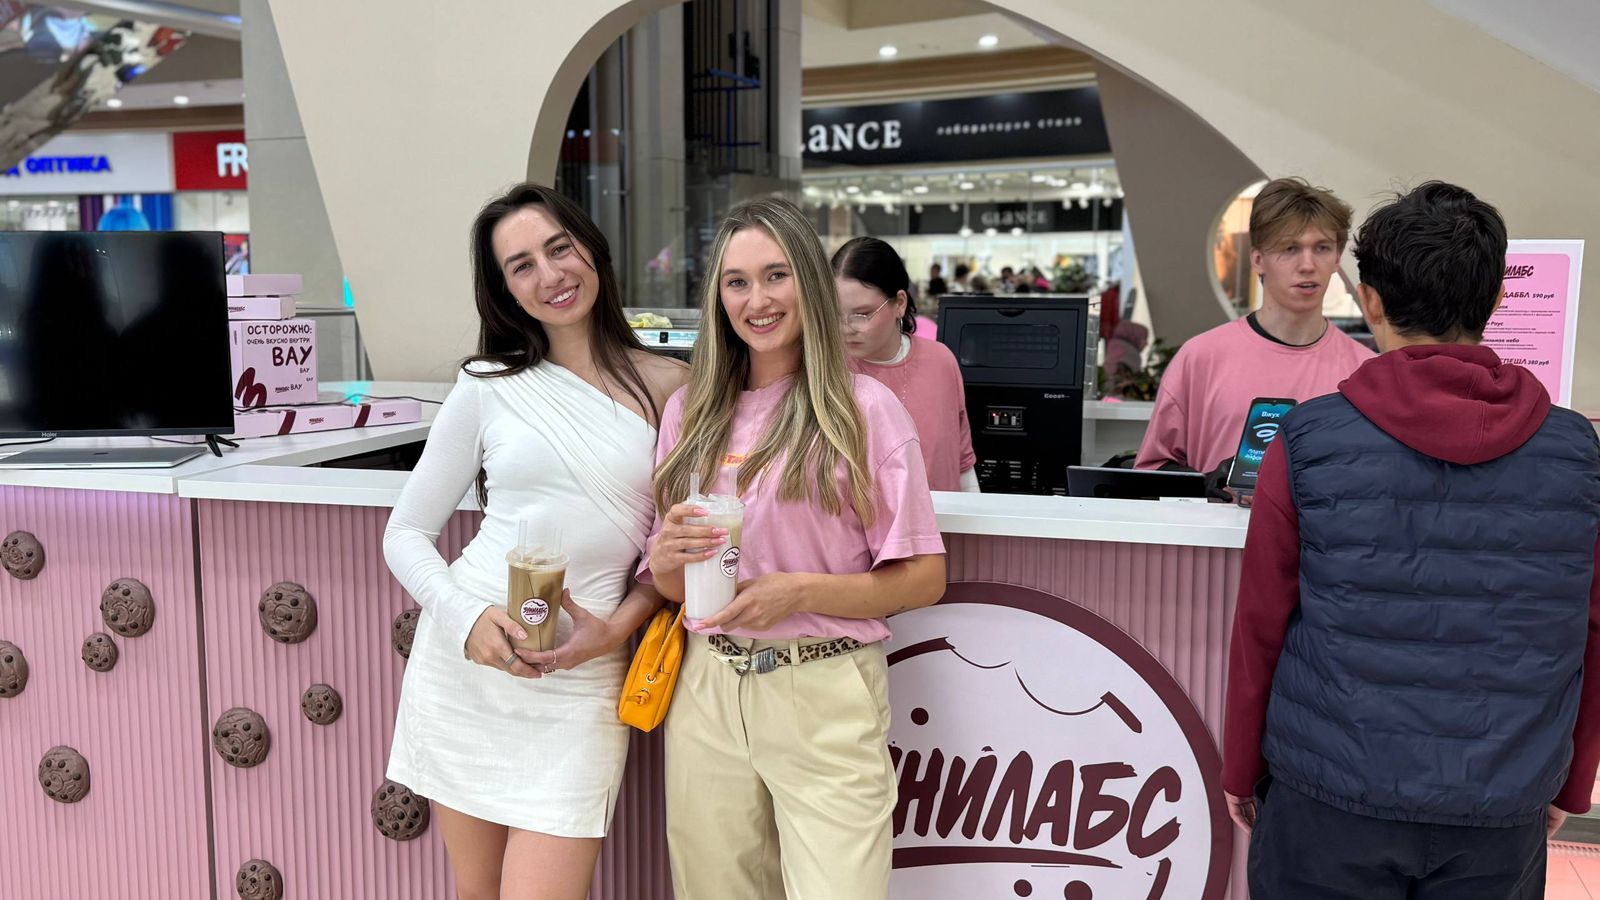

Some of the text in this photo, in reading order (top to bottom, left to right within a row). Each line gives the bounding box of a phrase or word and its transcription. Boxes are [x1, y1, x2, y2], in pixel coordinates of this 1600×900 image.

[800, 120, 902, 153] aNCE
[25, 155, 111, 174] ОПТИКА
[1504, 265, 1534, 277] ИЛАБС
[247, 324, 312, 335] ОСТОРОЖНО:
[272, 345, 313, 367] ВАУ
[888, 744, 1182, 859] НИЛАБС
